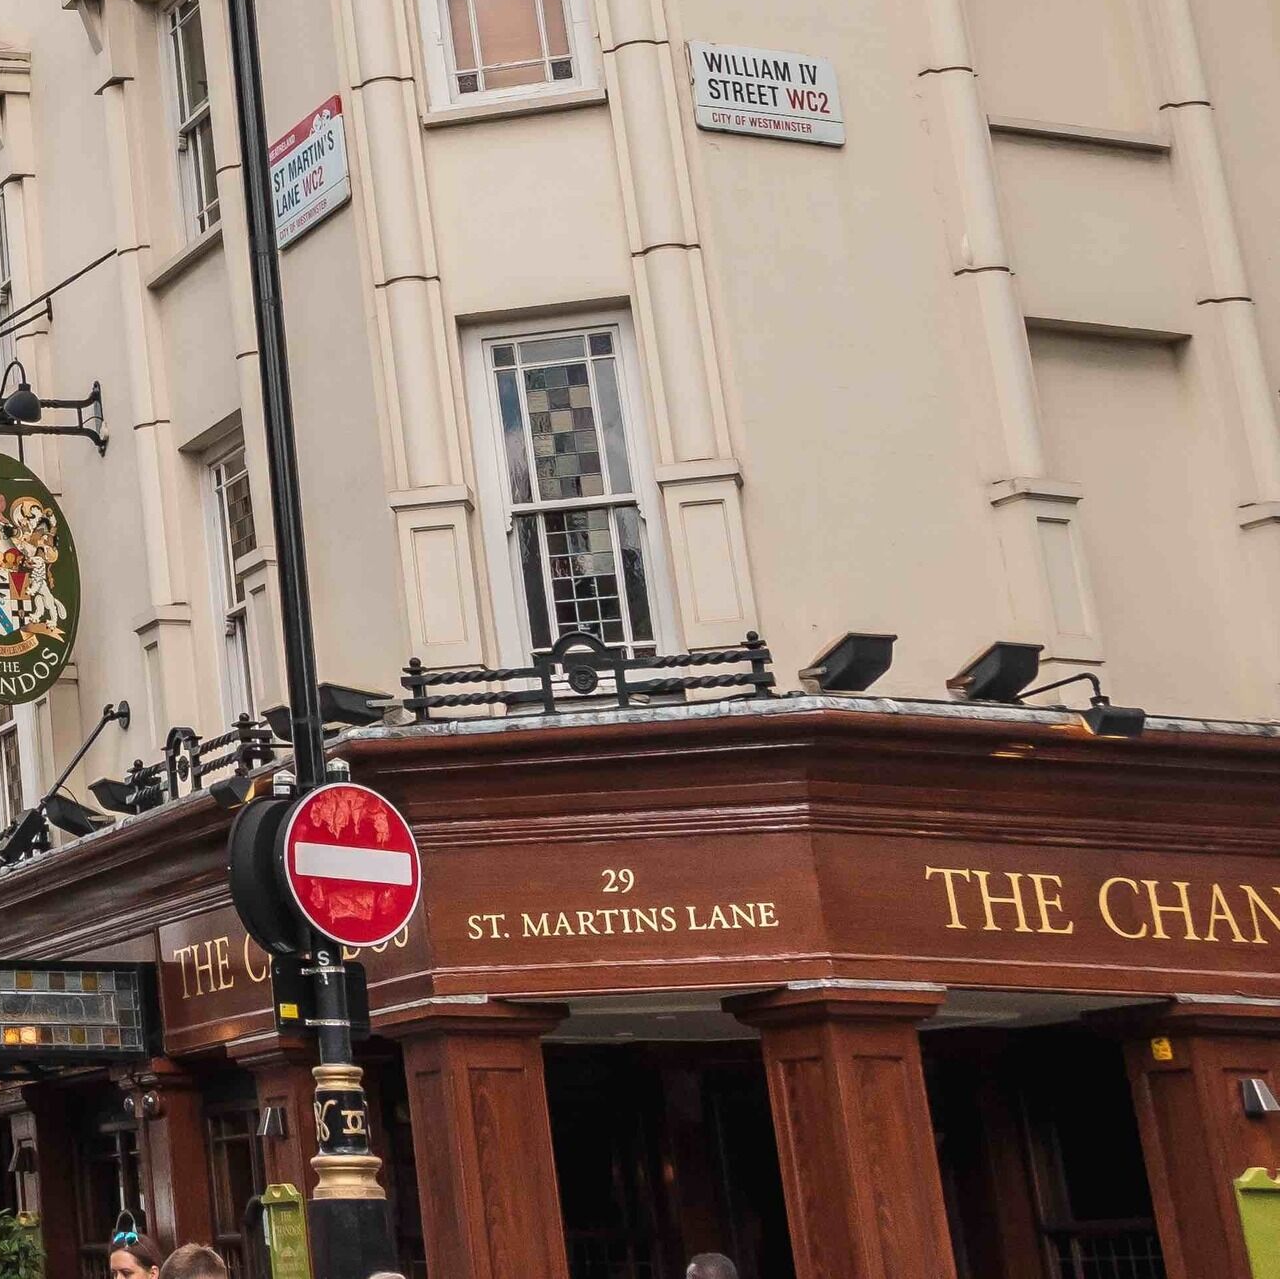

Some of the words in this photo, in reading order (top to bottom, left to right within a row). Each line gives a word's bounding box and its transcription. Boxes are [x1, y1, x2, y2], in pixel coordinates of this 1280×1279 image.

[703, 51, 792, 82] WILLIAM
[798, 63, 817, 85] IV
[708, 78, 779, 107] STREET
[785, 87, 831, 114] WC2
[712, 112, 731, 124] CITY
[735, 115, 746, 125] OF
[748, 116, 812, 133] WESTMINSTER
[273, 169, 285, 193] ST
[288, 130, 334, 183] MARTIN'S
[276, 183, 301, 218] LANE
[302, 165, 325, 198] WC2
[279, 227, 289, 240] CITY
[290, 222, 298, 234] OF
[297, 199, 328, 229] WESTMINSTER
[601, 868, 635, 894] 29
[924, 865, 1075, 935] THE
[467, 913, 510, 940] ST.
[521, 906, 677, 938] MARTINS
[686, 902, 779, 931] LANE
[174, 936, 234, 1000] THE
[318, 950, 330, 966] S
